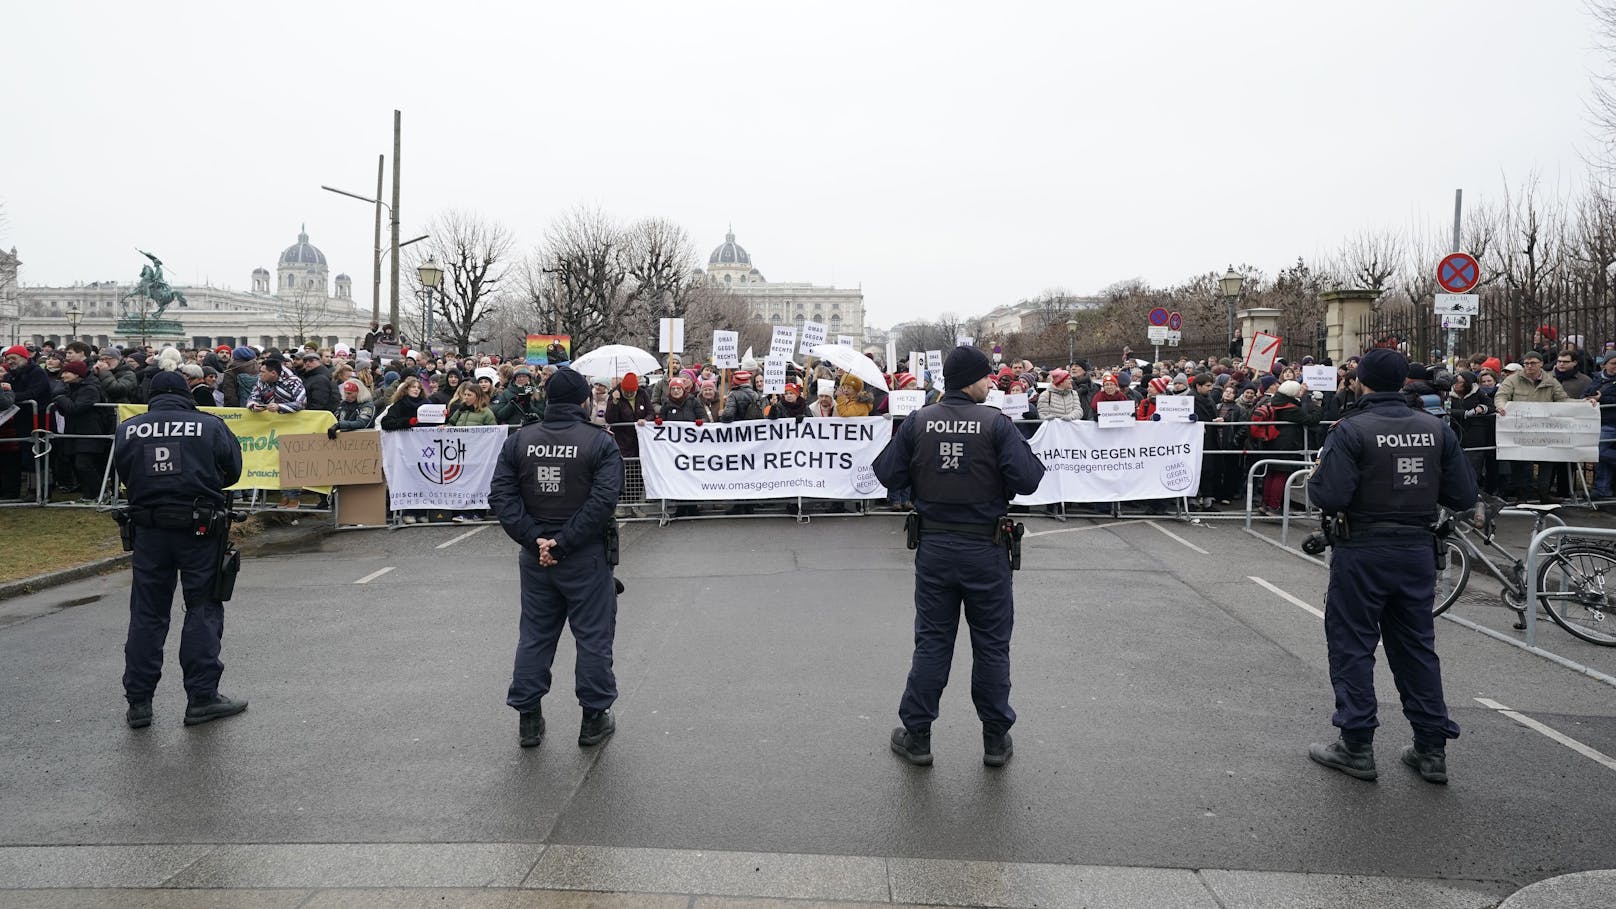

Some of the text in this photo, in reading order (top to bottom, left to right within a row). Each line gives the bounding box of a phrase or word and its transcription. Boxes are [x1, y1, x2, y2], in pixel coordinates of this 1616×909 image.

[804, 333, 824, 341] GEGEN
[126, 422, 202, 440] POLIZEI
[653, 422, 874, 443] ZUSAMMENHALTEN
[926, 420, 980, 434] POLIZEI
[1376, 433, 1435, 448] POLIZEI
[155, 447, 170, 461] D
[526, 444, 578, 458] POLIZEI
[940, 442, 964, 456] BE
[1044, 449, 1086, 460] HALTEN
[1091, 448, 1136, 460] GEGEN
[1140, 444, 1190, 458] RECHTS
[152, 462, 174, 472] 151
[328, 458, 378, 477] DANKE!
[674, 450, 852, 471] GEGEN RECHTS
[941, 456, 959, 469] 24
[1166, 462, 1184, 471] OMAS
[1397, 458, 1424, 473] BE
[538, 466, 560, 480] BE
[1166, 470, 1186, 478] GEGEN
[1403, 475, 1418, 485] 24
[540, 483, 559, 492] 120
[702, 478, 826, 491] www.omasgegenrechts.at
[1167, 476, 1190, 486] RECHTS
